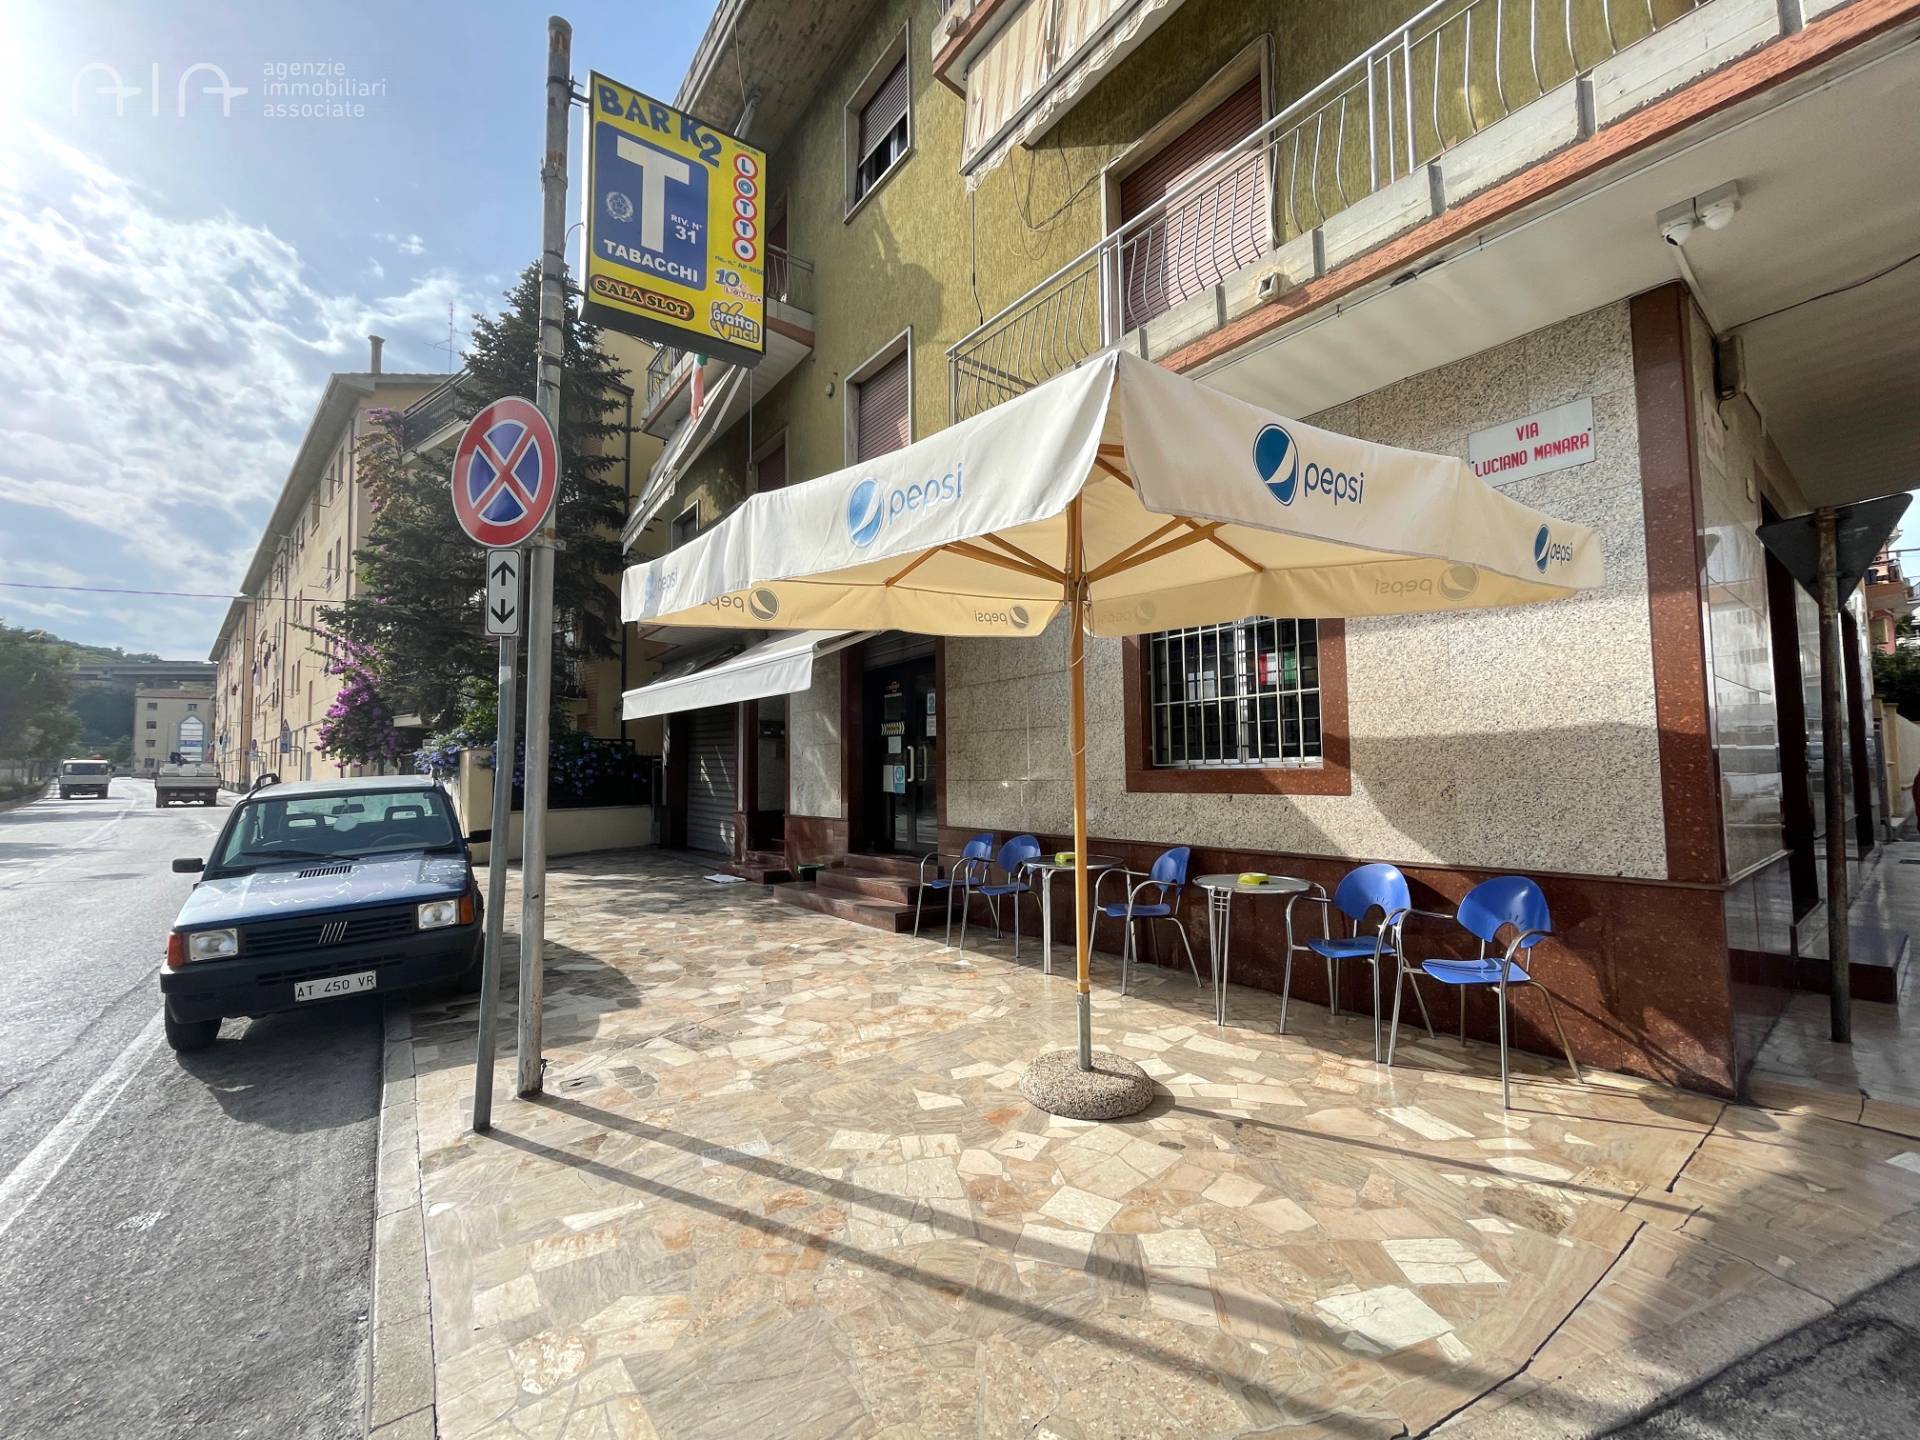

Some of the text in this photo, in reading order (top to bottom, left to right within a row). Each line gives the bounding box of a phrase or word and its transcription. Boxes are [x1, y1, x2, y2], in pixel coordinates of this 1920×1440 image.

[598, 84, 722, 168] BAR K2
[617, 135, 689, 253] T
[734, 155, 757, 260] LOTTO
[671, 214, 690, 227] RIV.
[675, 225, 696, 245] 31
[603, 239, 698, 283] TABACCHI
[715, 269, 740, 288] 10
[597, 279, 688, 316] SALA SLOT
[713, 309, 753, 330] Gratta
[1516, 422, 1539, 441] VIA
[1475, 432, 1590, 477] LUCIANO MANARA
[889, 462, 962, 526] pepsi
[1304, 462, 1364, 506] pepsi
[297, 975, 375, 998] AT 450 VR
